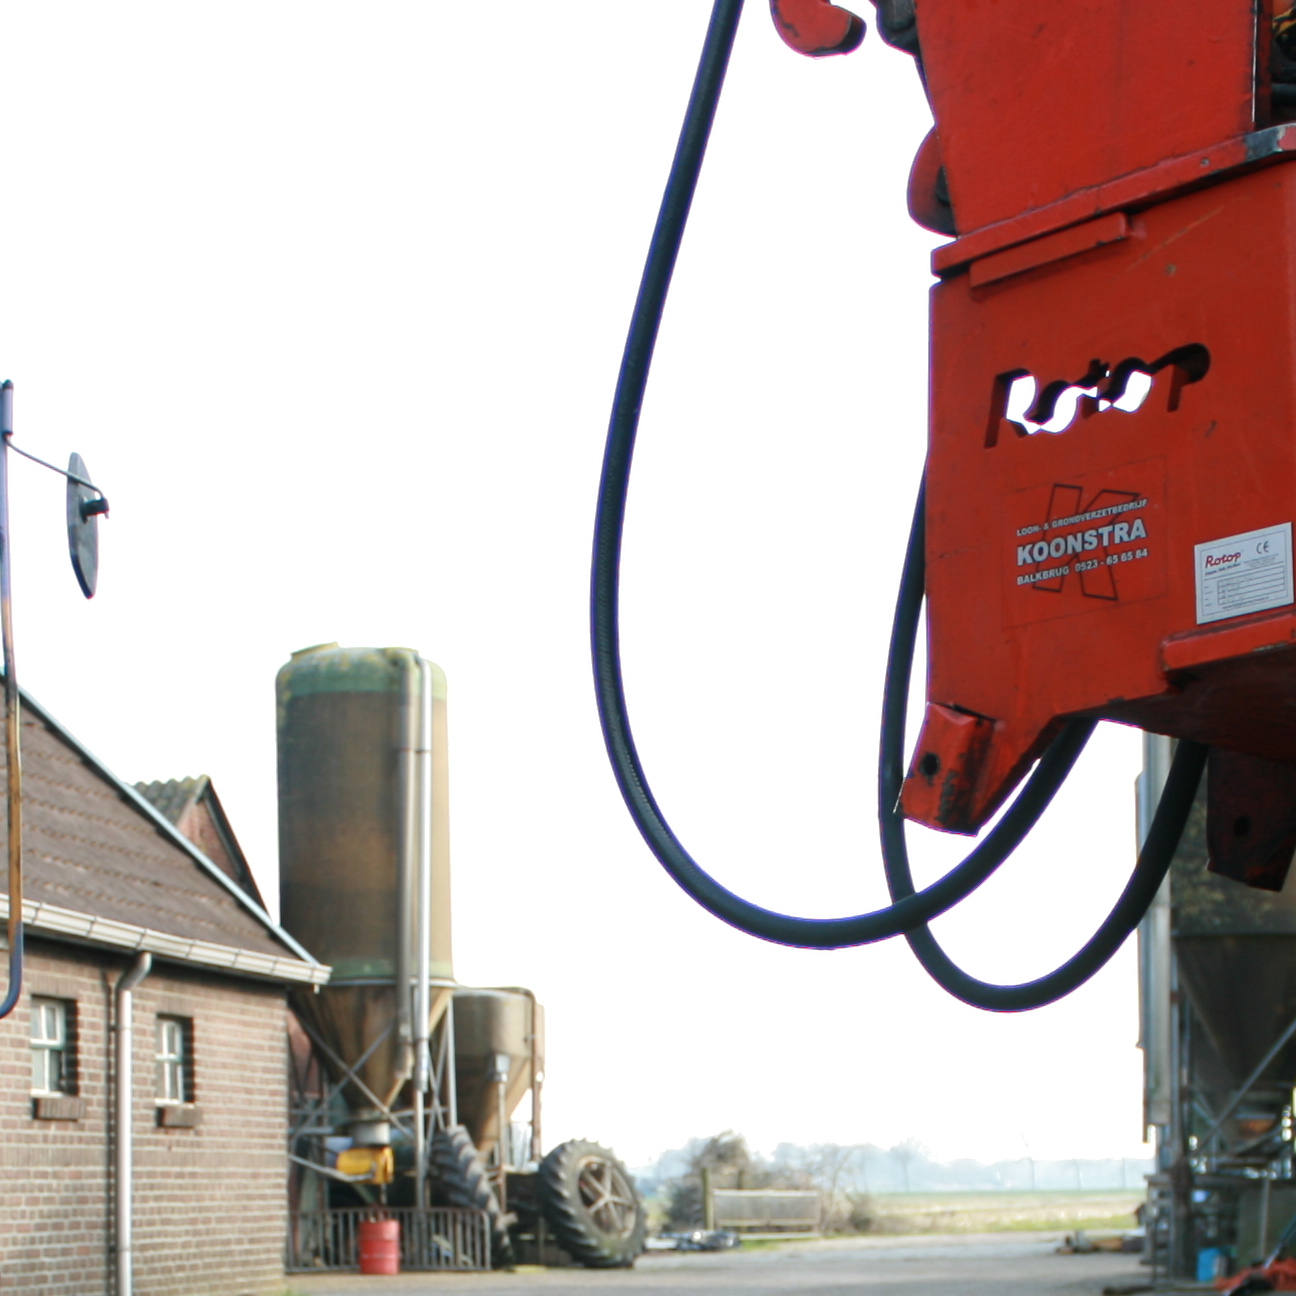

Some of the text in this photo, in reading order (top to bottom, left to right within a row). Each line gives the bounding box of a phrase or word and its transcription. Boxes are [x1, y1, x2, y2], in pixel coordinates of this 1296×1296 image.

[984, 342, 1211, 449] Rotop
[1016, 518, 1147, 567] KOONSTRA
[1205, 551, 1242, 569] Rotop
[1016, 566, 1070, 586] BALKBRUG
[1074, 558, 1099, 573] 0523
